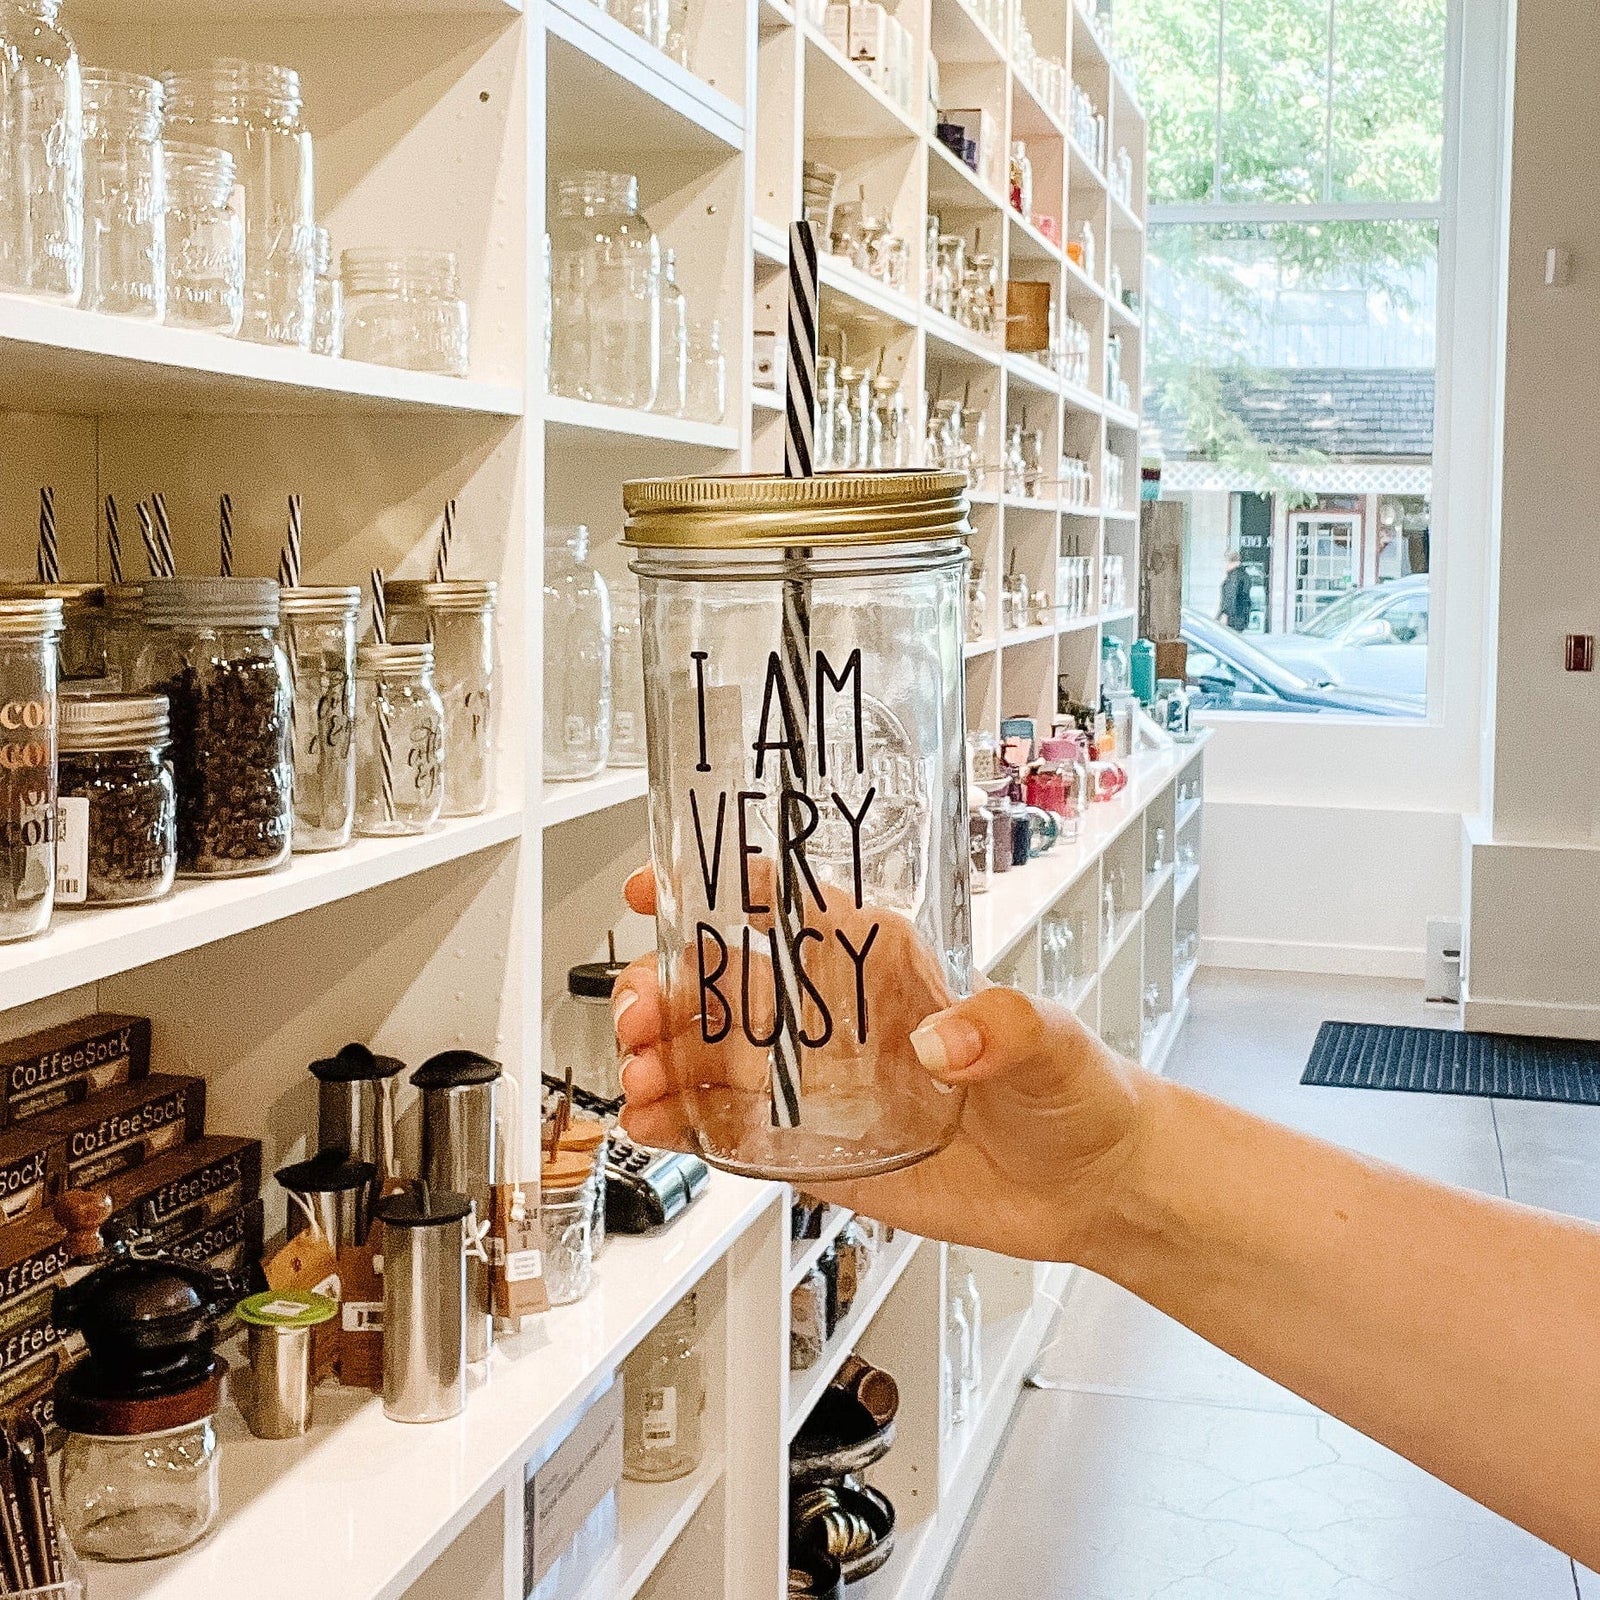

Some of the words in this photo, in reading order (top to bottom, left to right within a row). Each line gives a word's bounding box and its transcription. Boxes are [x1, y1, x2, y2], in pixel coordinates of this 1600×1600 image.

[690, 651, 711, 772] I
[752, 648, 864, 779] AM
[689, 787, 876, 914] VERY
[696, 922, 879, 1048] BUSY
